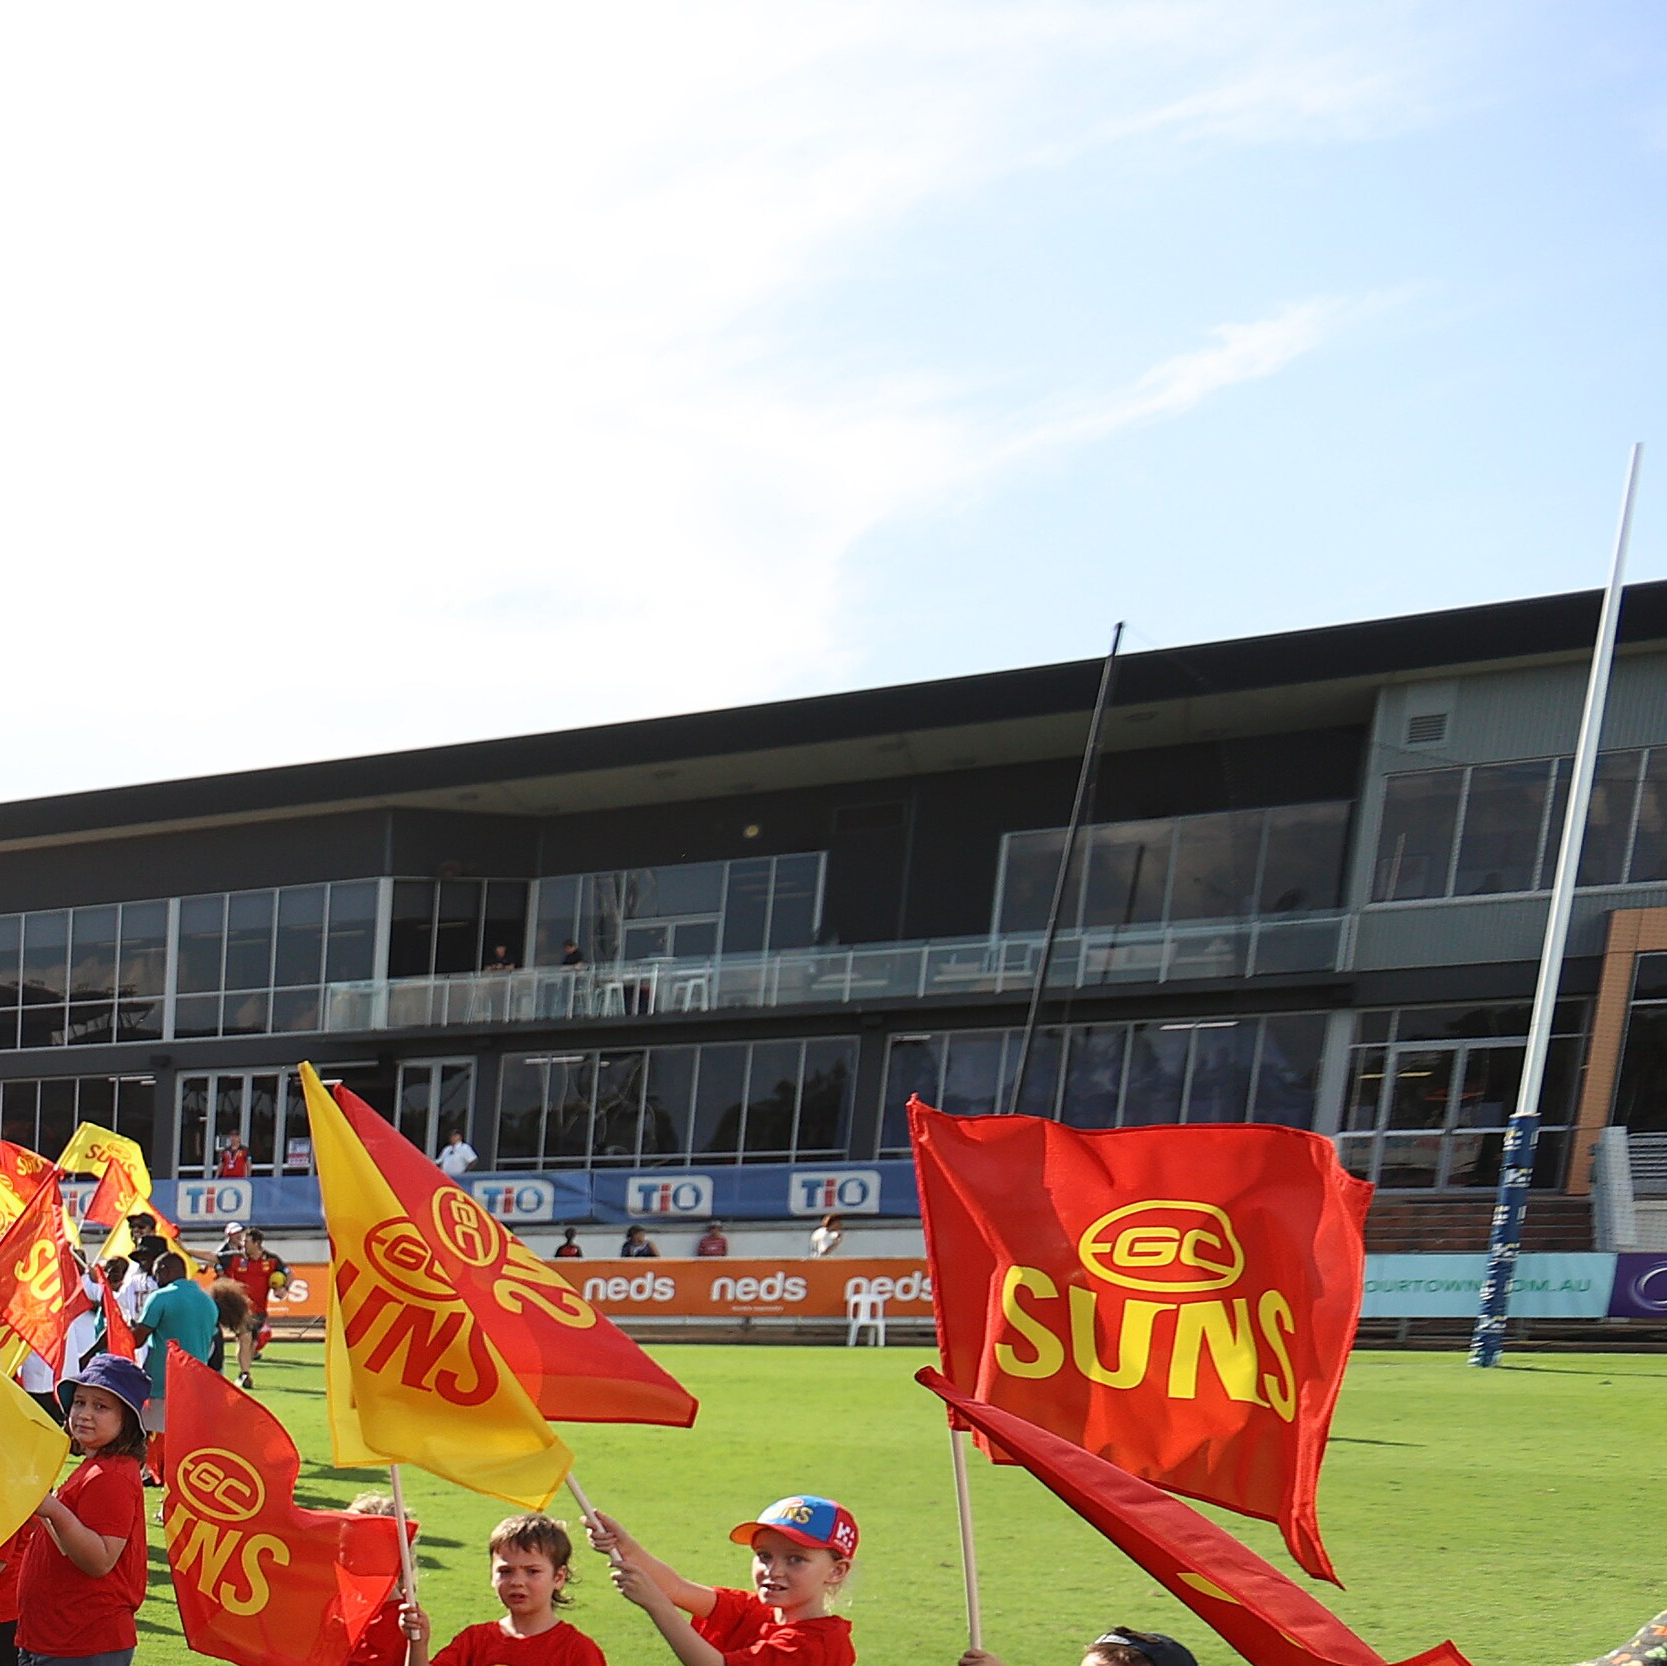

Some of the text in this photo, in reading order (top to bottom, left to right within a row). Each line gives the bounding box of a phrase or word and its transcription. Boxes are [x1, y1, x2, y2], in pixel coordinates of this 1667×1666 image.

[85, 1144, 138, 1180] SUS
[186, 1186, 243, 1214] TiO
[481, 1186, 543, 1214] TiO
[637, 1181, 703, 1212] TiO
[800, 1178, 867, 1208] TiO
[14, 1239, 64, 1314] SU
[583, 1271, 676, 1302] neds
[711, 1271, 808, 1302] neds
[844, 1271, 932, 1302] neds
[1364, 1278, 1592, 1294] OURTOWNOM.AU
[331, 1261, 499, 1407] NS
[992, 1265, 1297, 1422] SUNS
[166, 1502, 289, 1616] NS
